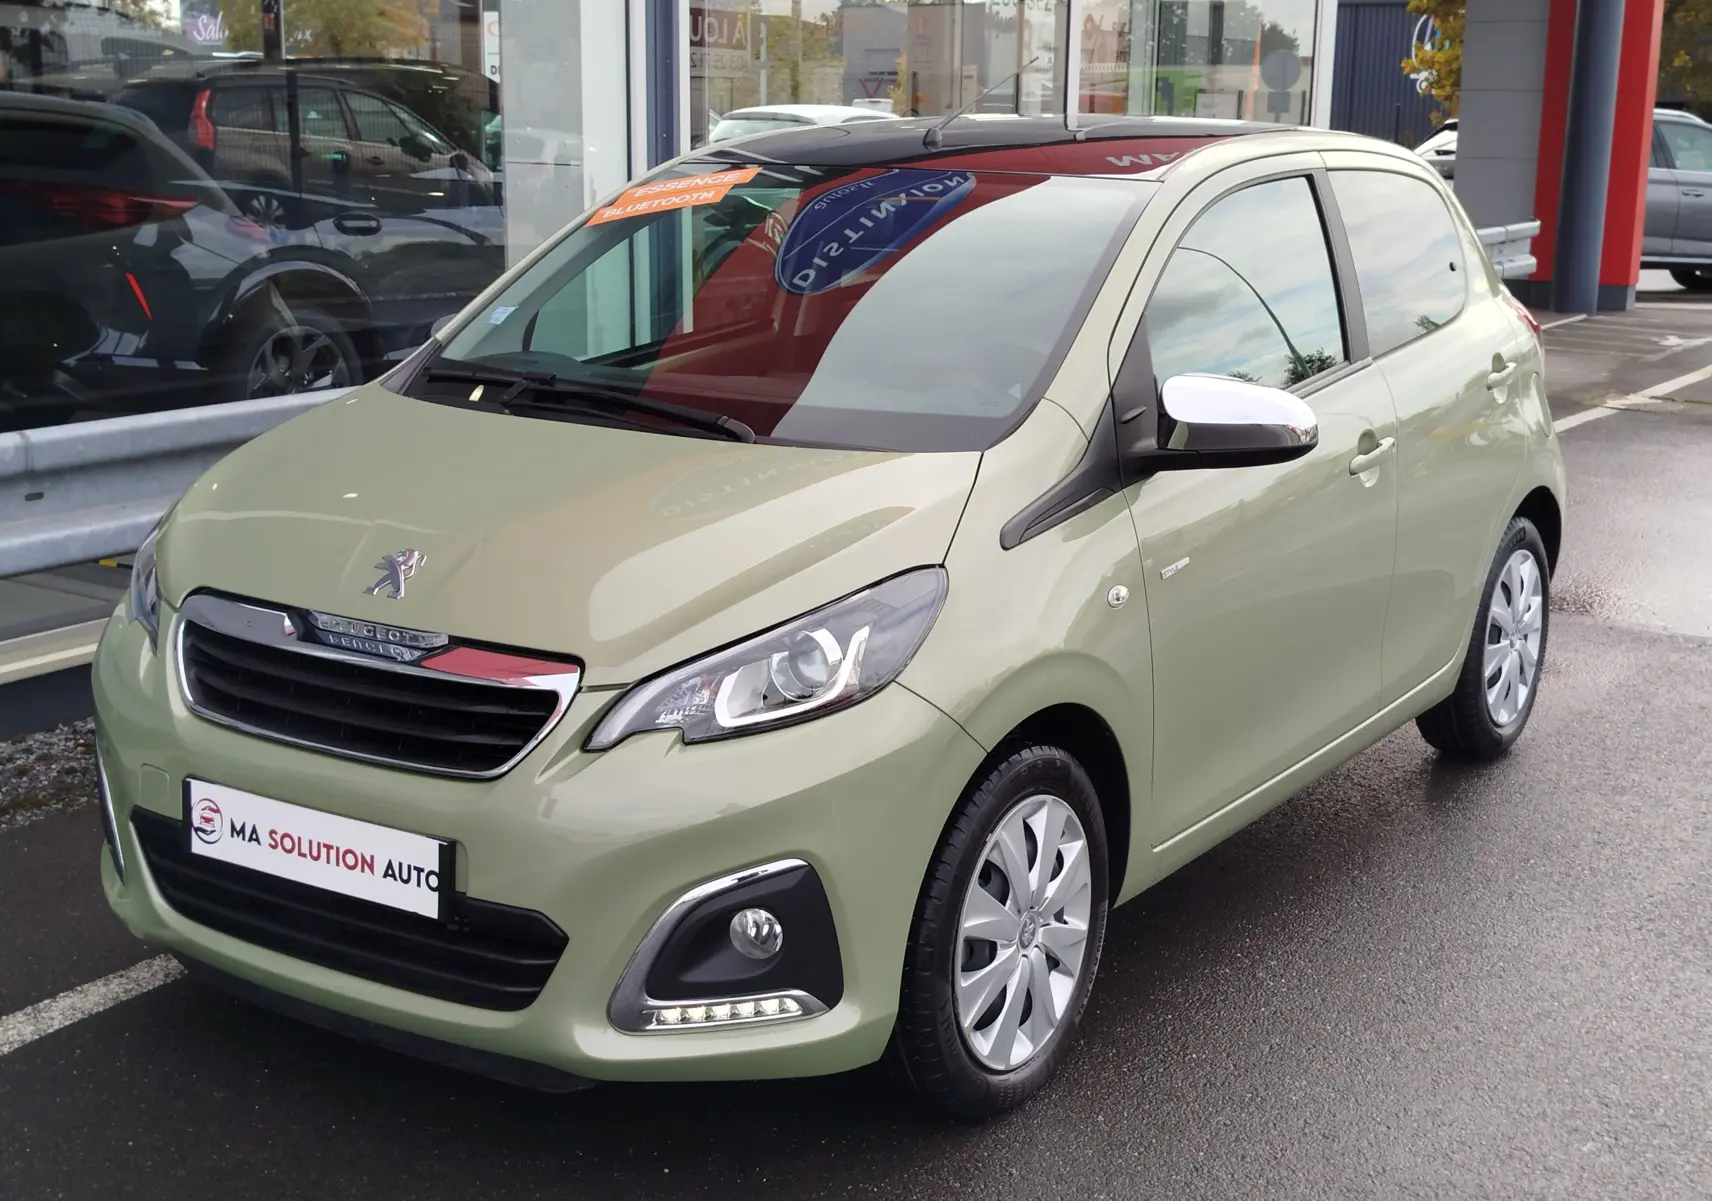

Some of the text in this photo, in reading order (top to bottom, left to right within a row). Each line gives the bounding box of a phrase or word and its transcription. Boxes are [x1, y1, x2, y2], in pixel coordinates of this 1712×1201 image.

[634, 172, 741, 197] ESSENCE
[602, 190, 716, 219] BLUETOOTH
[230, 818, 440, 893] MA SOLUTION AUTO
